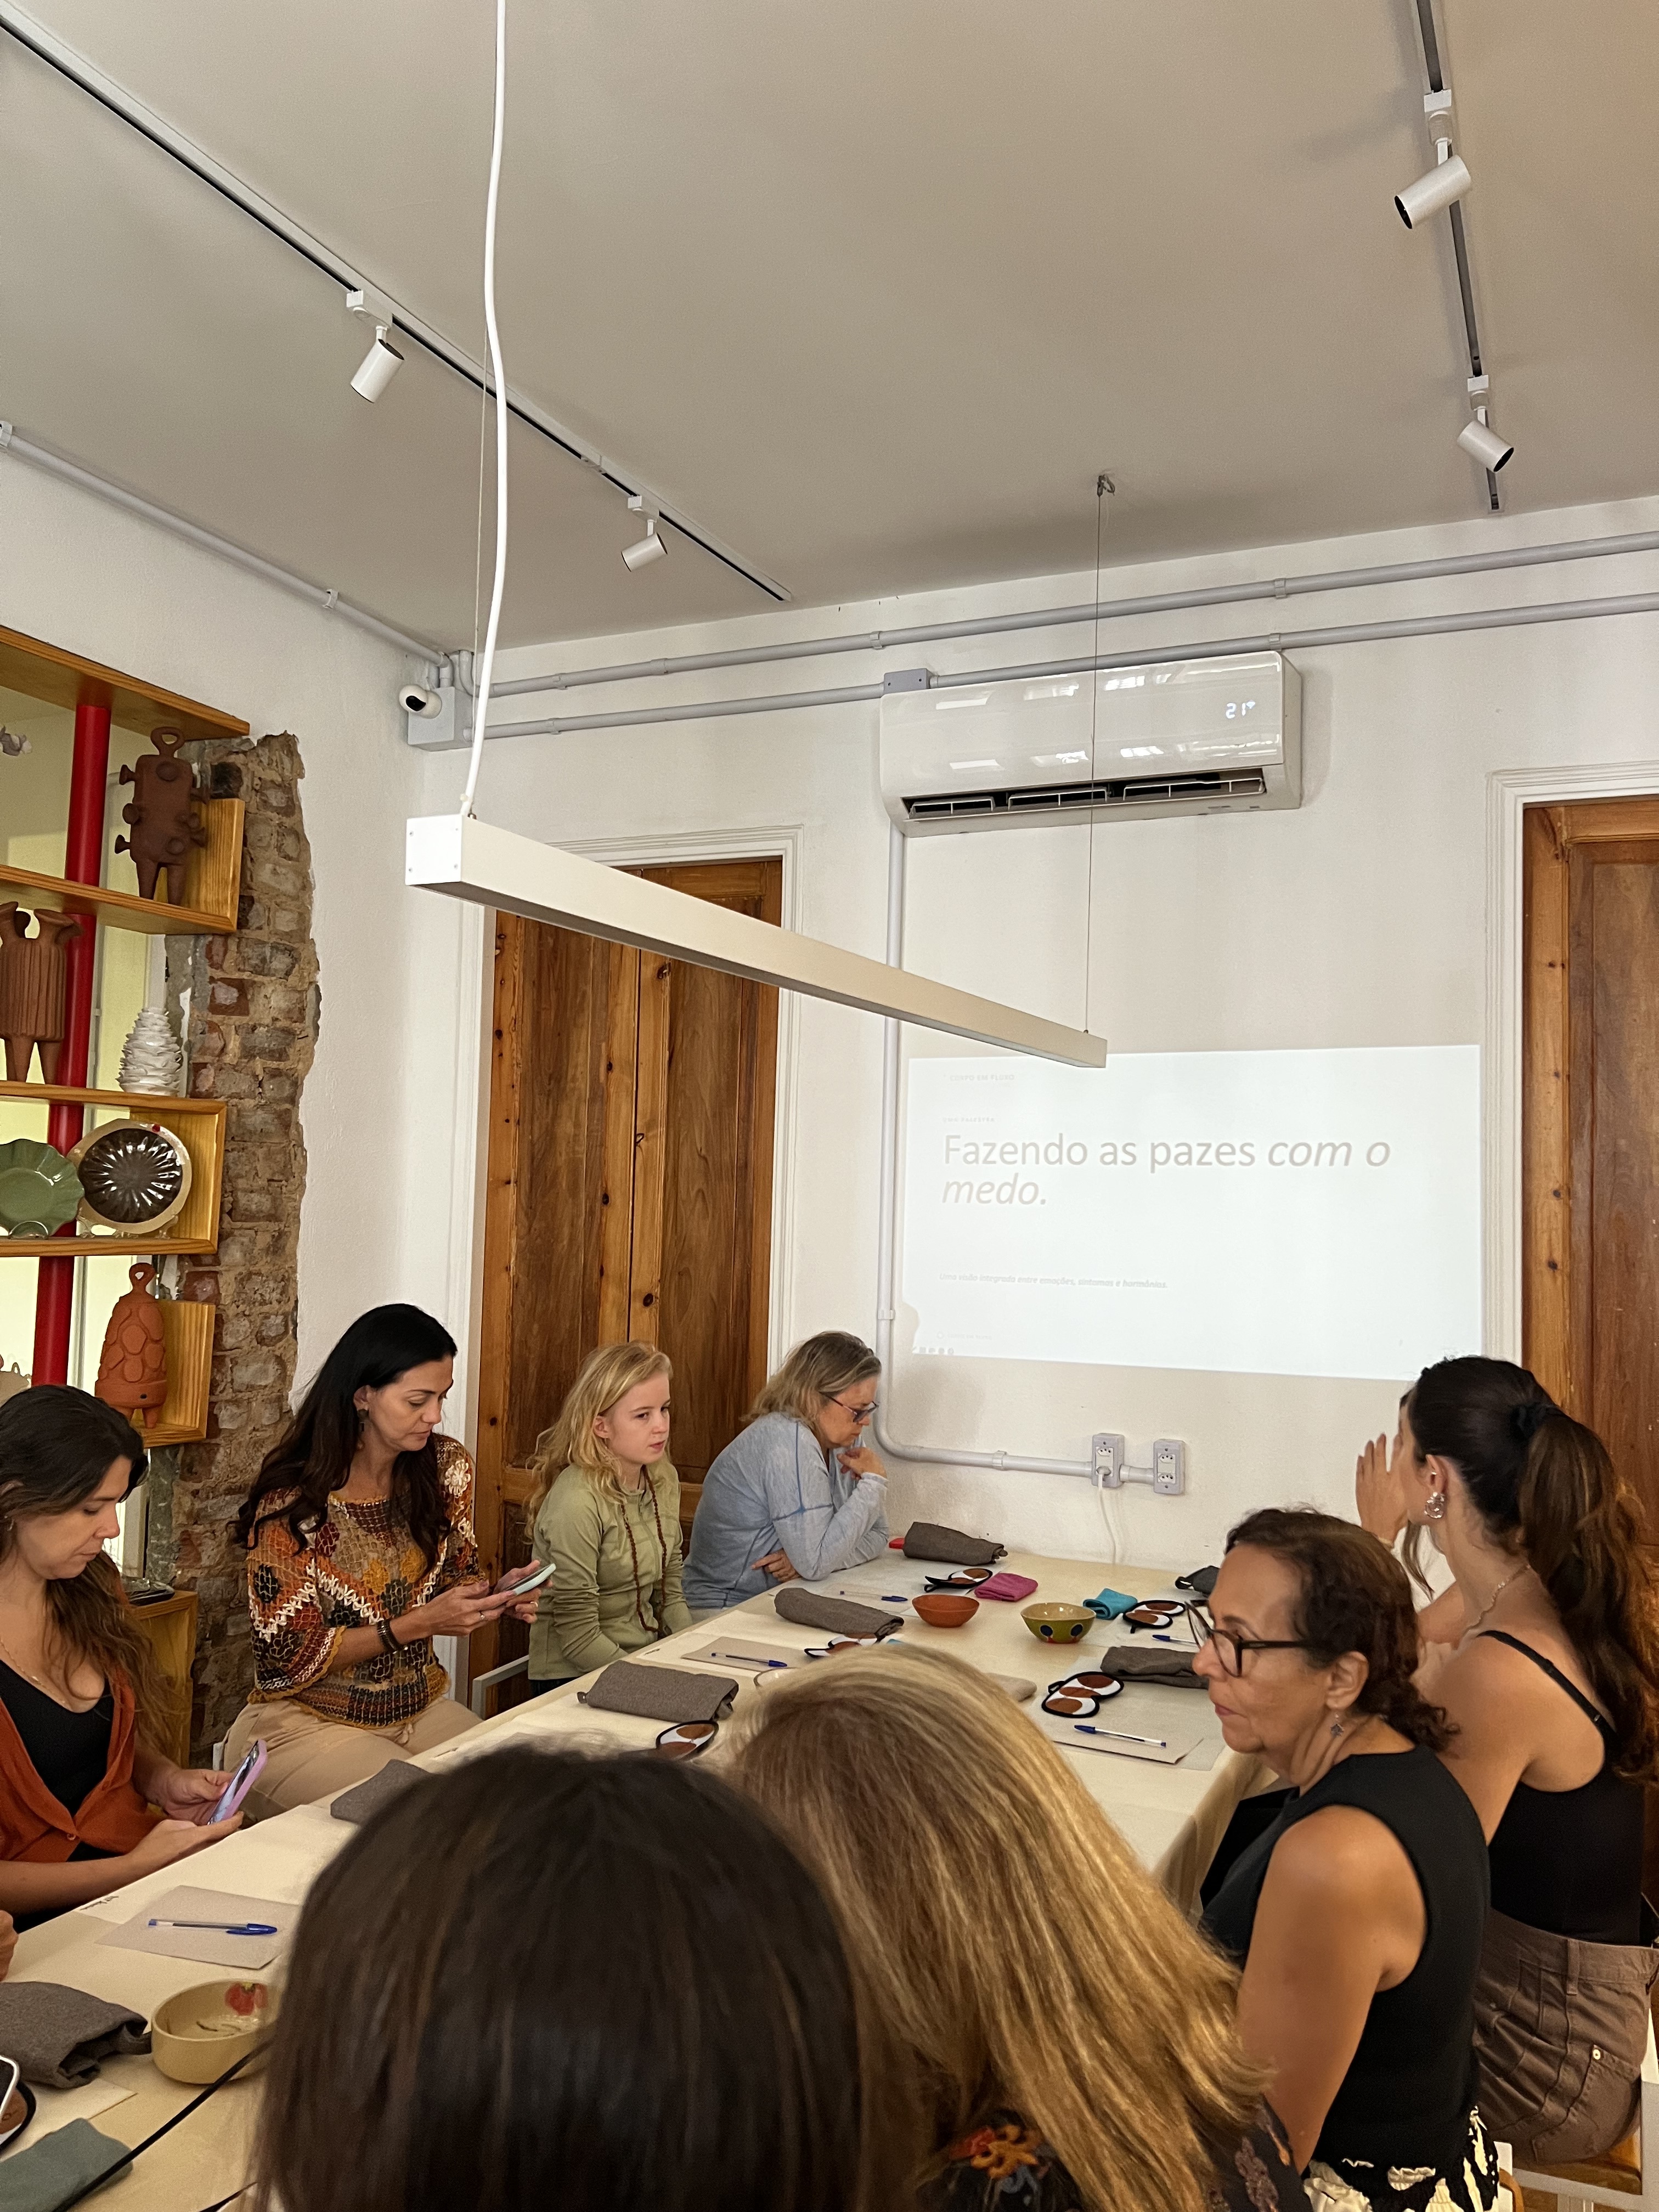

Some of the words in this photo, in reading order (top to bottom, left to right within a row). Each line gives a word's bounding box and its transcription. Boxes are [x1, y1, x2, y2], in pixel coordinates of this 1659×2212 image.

[1225, 702, 1246, 719] 21
[944, 1133, 1088, 1166] Fazendo
[1099, 1142, 1137, 1166] as
[1150, 1141, 1256, 1174] pazes
[1267, 1141, 1353, 1167] com
[1365, 1141, 1391, 1167] o
[941, 1172, 1047, 1205] medo.
[979, 1274, 1016, 1284] integrada
[1077, 1278, 1114, 1287] sintomas
